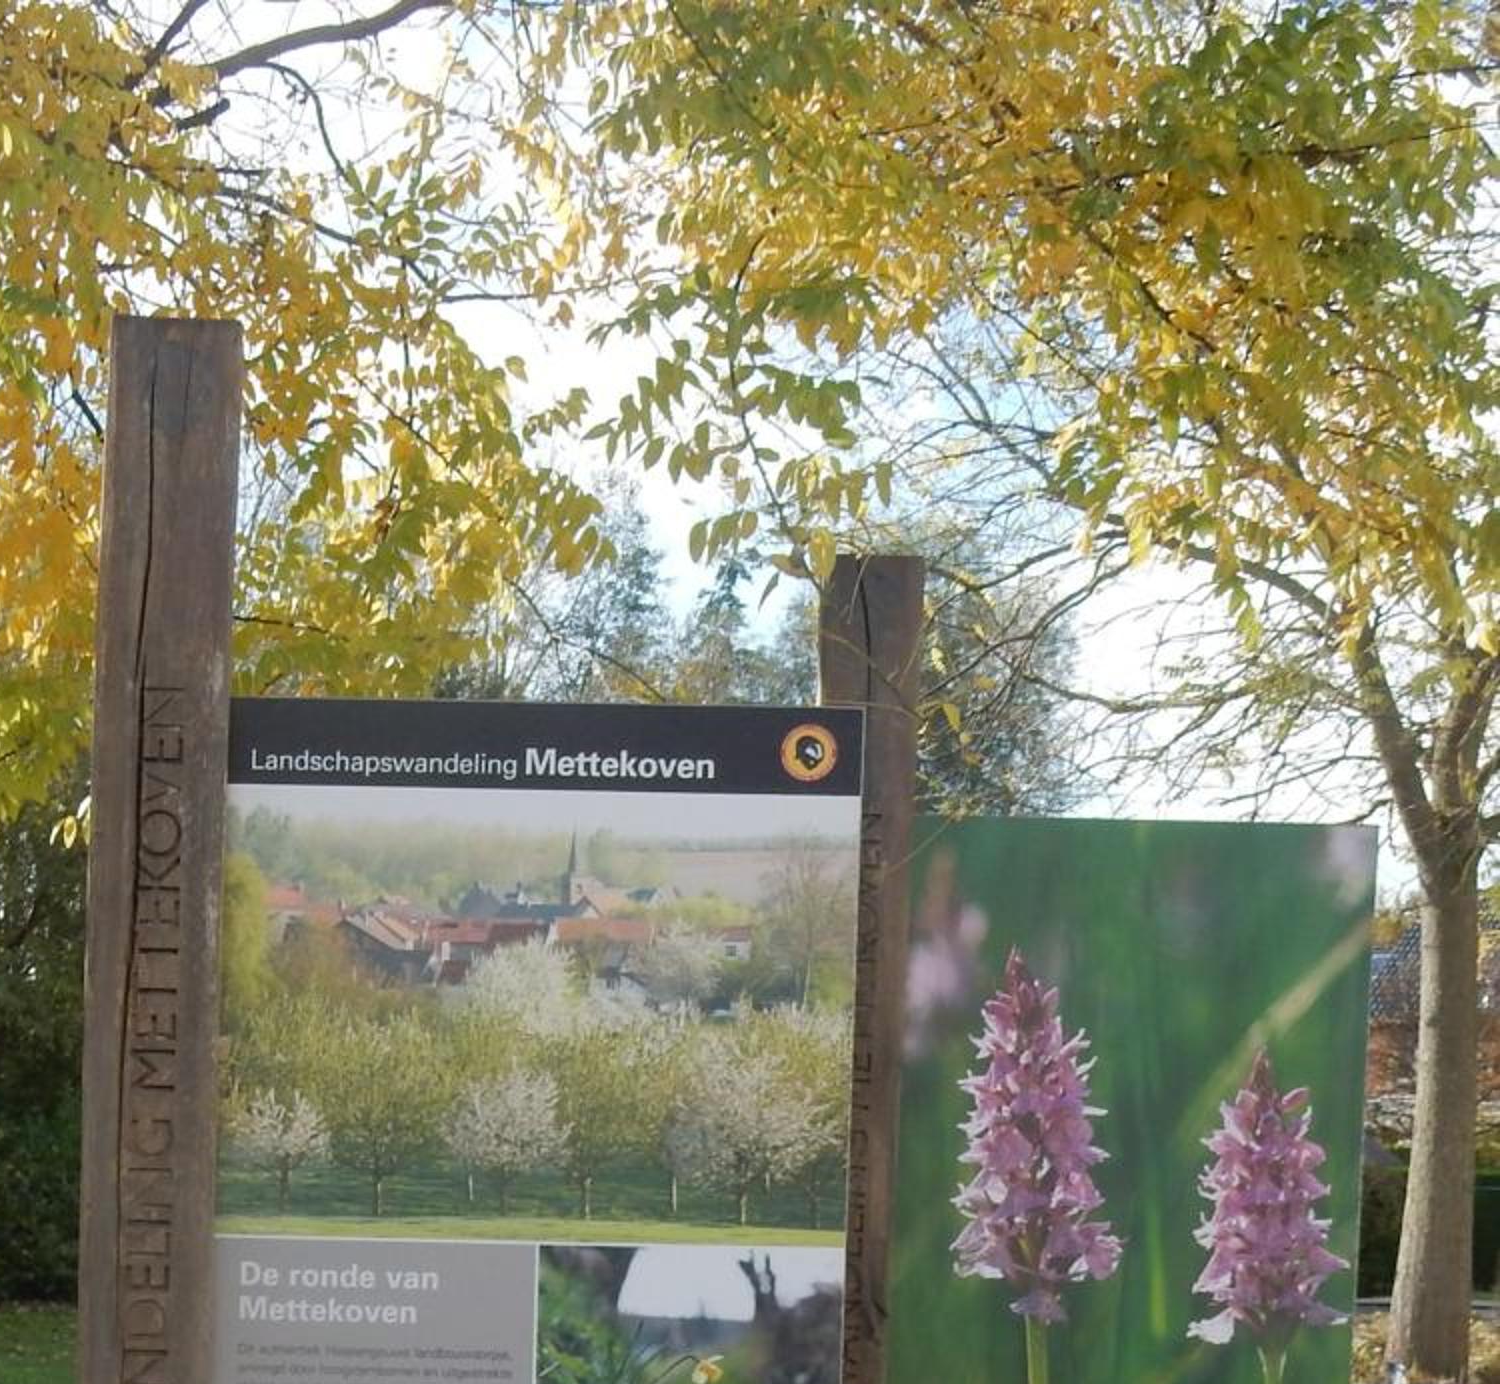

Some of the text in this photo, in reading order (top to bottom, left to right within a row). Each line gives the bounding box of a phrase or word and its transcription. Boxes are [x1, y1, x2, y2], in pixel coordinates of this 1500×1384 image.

[249, 747, 716, 781] Landschapswandeling Mettekoven
[128, 687, 186, 1096] METTEKOVEN
[239, 1260, 440, 1291] De ronde van
[238, 1295, 418, 1325] Mettekoven
